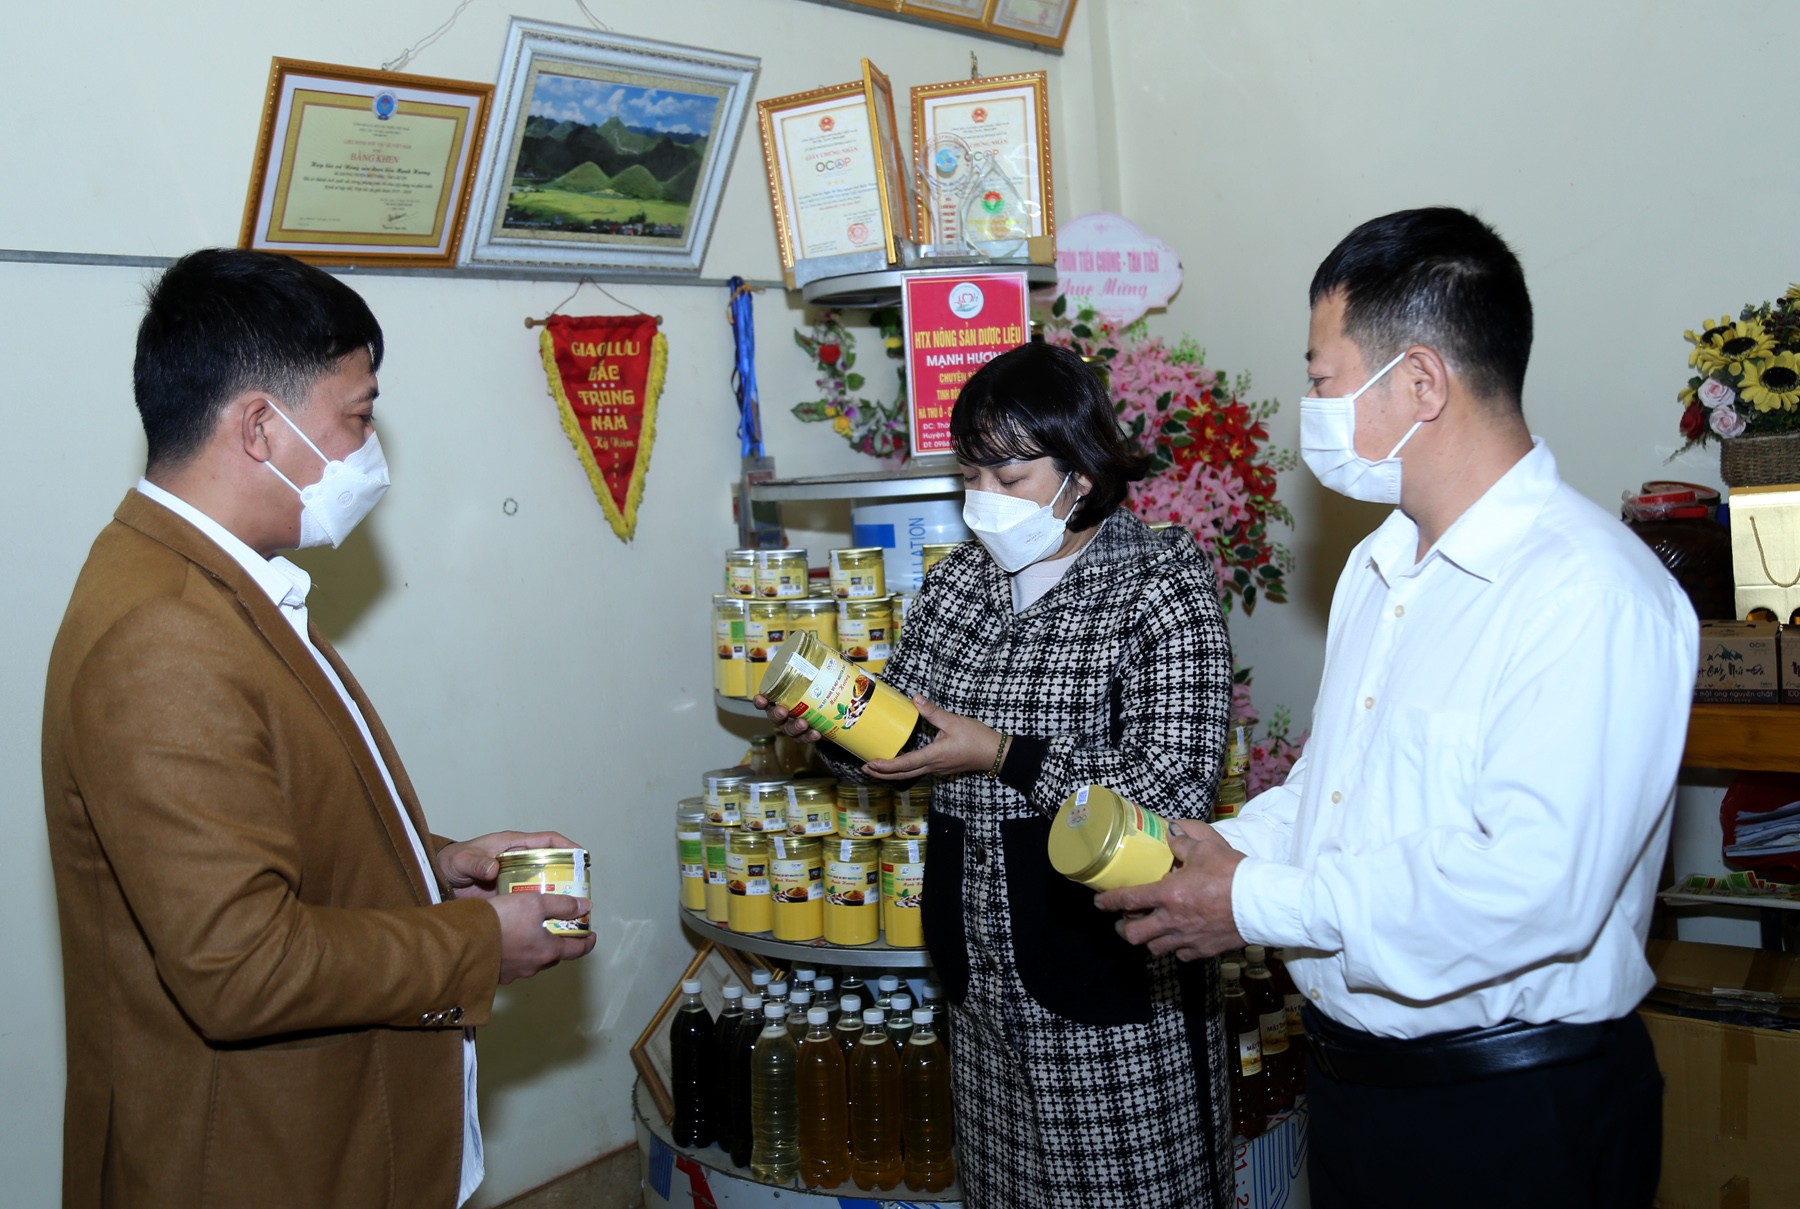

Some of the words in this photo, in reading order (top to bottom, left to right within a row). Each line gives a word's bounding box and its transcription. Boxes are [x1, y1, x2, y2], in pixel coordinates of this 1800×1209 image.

[815, 157, 852, 173] OCOP
[915, 330, 932, 350] HTX
[934, 326, 957, 349] NÔNG
[959, 321, 976, 347] SẢN
[978, 326, 1001, 349] DƯỢC
[1003, 322, 1021, 348] LIỆU
[571, 341, 606, 357] GIAO
[926, 353, 964, 369] MẠNH
[578, 389, 635, 407] TRUNG
[591, 415, 628, 431] NAM
